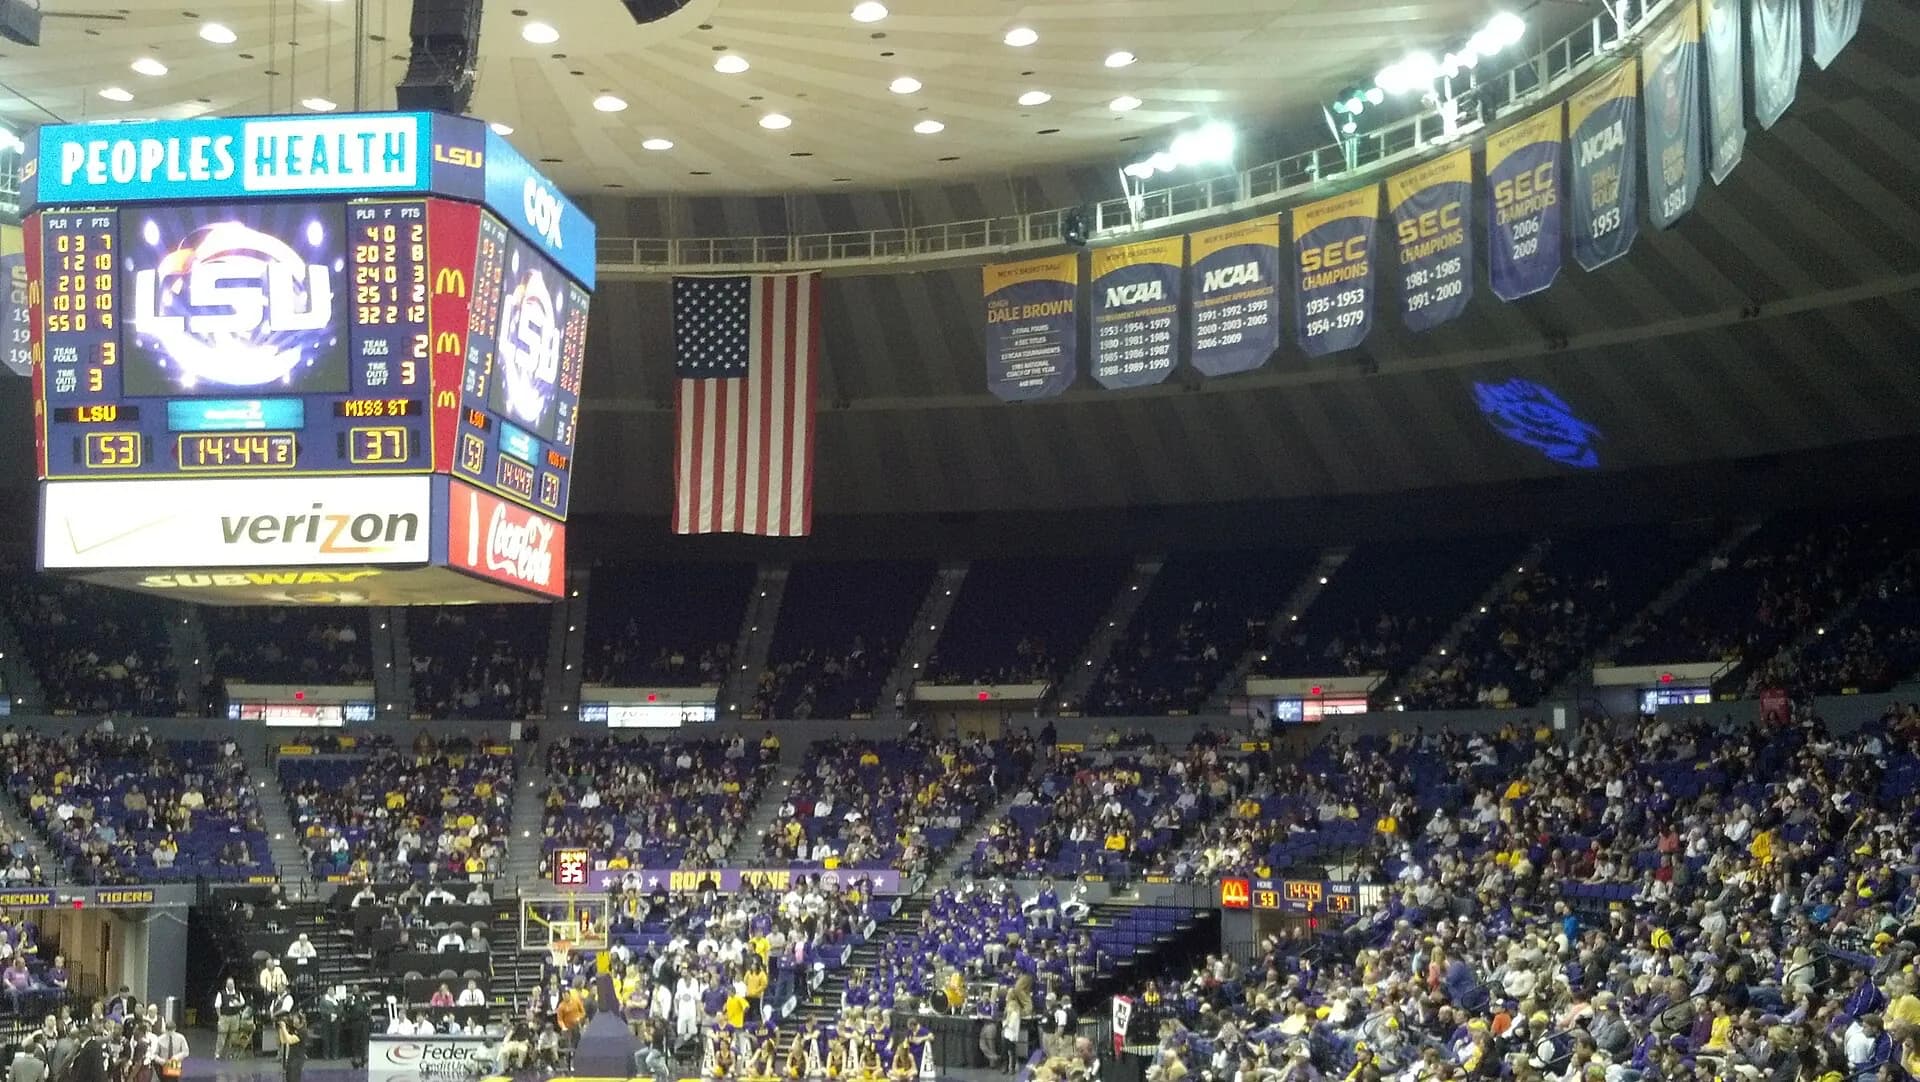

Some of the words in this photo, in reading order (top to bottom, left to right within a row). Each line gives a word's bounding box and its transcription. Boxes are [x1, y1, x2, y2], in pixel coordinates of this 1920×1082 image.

[1580, 119, 1624, 168] NCAA
[60, 134, 236, 187] PEOPLES
[254, 131, 406, 177] HEALTH
[434, 143, 483, 169] LSU
[1494, 160, 1554, 209] SEC
[1591, 163, 1619, 191] FINAL
[1496, 188, 1556, 226] CHAMPIONS
[1591, 181, 1619, 211] FOUR
[76, 218, 83, 228] F
[91, 217, 111, 229] PTS
[384, 209, 392, 218] F
[401, 208, 421, 218] PTS
[523, 176, 565, 249] COX
[1398, 201, 1461, 246] SEC
[1592, 207, 1621, 239] 1953
[367, 226, 379, 242] 4
[383, 225, 396, 242] 0
[411, 224, 423, 242] 2
[1512, 215, 1539, 240] 2006
[57, 235, 69, 253] 0
[74, 235, 85, 252] 3
[101, 234, 112, 250] 7
[356, 245, 379, 263] 20
[384, 245, 396, 262] 2
[412, 244, 424, 262] 8
[1301, 234, 1367, 273] SEC
[1400, 228, 1464, 264] CHAMPIONS
[1512, 238, 1538, 260] 2009
[74, 254, 85, 271] 2
[1406, 269, 1428, 290] 1981
[1435, 257, 1461, 279] 1985
[59, 275, 70, 292] 2
[74, 274, 86, 292] 0
[95, 274, 112, 291] 10
[356, 266, 380, 284] 24
[384, 266, 397, 283] 0
[413, 265, 425, 283] 3
[1203, 261, 1260, 293] NCAA
[1302, 260, 1369, 291] CHAMPIONS
[75, 294, 86, 311] 0
[135, 264, 332, 334] LSU
[357, 286, 381, 304] 25
[391, 287, 397, 302] 1
[412, 284, 426, 303] 2
[1104, 279, 1163, 309] NCAA
[1306, 296, 1330, 316] 1935
[1336, 288, 1364, 308] 1953
[1407, 291, 1430, 312] 1991
[1436, 279, 1462, 301] 2000
[14, 308, 31, 323] 19
[358, 306, 381, 325] 32
[386, 306, 398, 324] 2
[408, 305, 425, 323] 12
[988, 306, 1021, 324] DALE
[1023, 299, 1073, 319] BROWN
[1198, 310, 1217, 322] 1991
[1222, 305, 1242, 318] 1992
[1247, 300, 1268, 312] 1993
[48, 314, 70, 332] 55
[75, 314, 86, 331] 0
[101, 313, 113, 330] 9
[1099, 326, 1118, 337] 1953
[1124, 321, 1144, 333] 1954
[1150, 318, 1170, 330] 1979
[1197, 323, 1217, 336] 2000
[1222, 318, 1242, 332] 2003
[1247, 313, 1268, 327] 2005
[1306, 317, 1330, 337] 1954
[1336, 309, 1364, 329] 1979
[12, 328, 31, 343] 19
[414, 334, 429, 358] 2
[1124, 335, 1143, 347] 1981
[1197, 337, 1217, 350] 2006
[1222, 332, 1242, 345] 2009
[10, 348, 33, 365] 199
[102, 342, 116, 366] 3
[1124, 348, 1144, 360] 1986
[1150, 344, 1170, 356] 1987
[401, 361, 416, 385] 3
[1149, 358, 1170, 370] 1990
[89, 368, 103, 392] 3
[78, 407, 116, 422] LSU
[469, 409, 485, 430] LSU
[100, 436, 135, 465] 53
[199, 437, 268, 466] 14:44
[277, 445, 287, 462] 2
[366, 430, 401, 460] 37
[468, 439, 481, 471] 53
[220, 503, 419, 553] verizon
[137, 568, 382, 588] SUBWAY
[561, 862, 583, 883] 35
[670, 870, 721, 890] ROAR
[97, 890, 153, 904] TIGERS
[1260, 892, 1274, 905] 53
[1290, 882, 1320, 899] 14:44
[1332, 885, 1352, 894] GUEST
[422, 1043, 479, 1060] Feder
